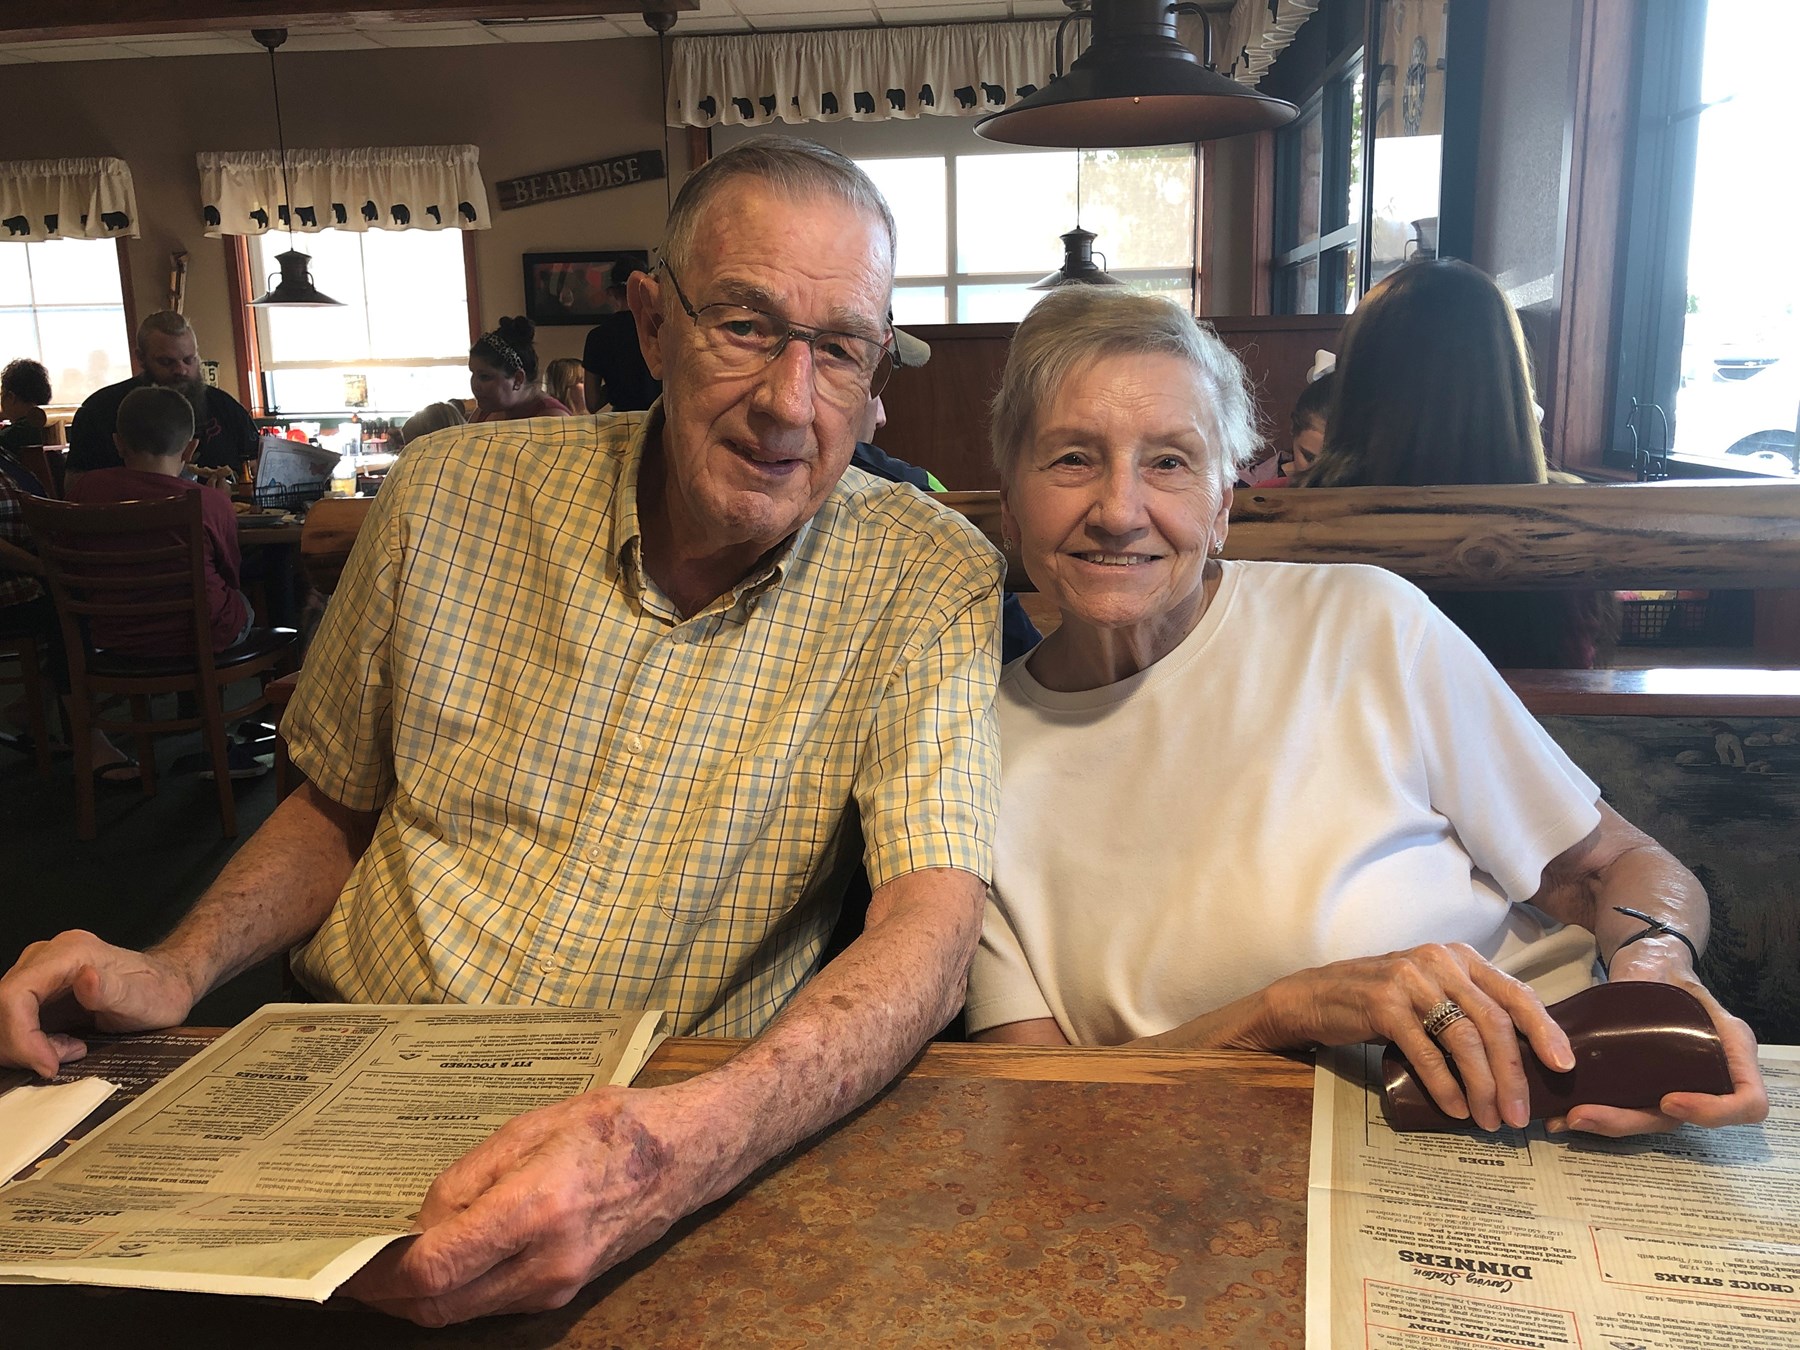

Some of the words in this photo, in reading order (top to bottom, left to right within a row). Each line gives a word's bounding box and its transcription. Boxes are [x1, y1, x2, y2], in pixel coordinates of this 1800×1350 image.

[513, 157, 642, 204] BEARADISE
[235, 1072, 310, 1081] BEVERAGES
[1458, 1157, 1505, 1166] SIDES
[1366, 1209, 1402, 1218] cornbread
[1441, 1224, 1476, 1232] described.
[1472, 1220, 1492, 1228] salad
[1374, 1230, 1398, 1238] enjoy
[1387, 1228, 1414, 1236] meant
[1454, 1230, 1475, 1238] after
[1488, 1228, 1512, 1236] platter
[1477, 1233, 1501, 1241] Daily
[1533, 1233, 1554, 1241] Enjoy
[1492, 1246, 1517, 1254] when
[1508, 1242, 1548, 1252] delicious
[1550, 1246, 1572, 1254] rich,
[1464, 1250, 1522, 1260] slow-roasted
[1545, 1252, 1576, 1260] carved
[1656, 1254, 1684, 1263] Topped
[1398, 1250, 1532, 1280] DINNERS
[1722, 1262, 1748, 1270] cals.)
[1413, 1268, 1461, 1286] Station
[1654, 1273, 1723, 1286] STEAKS
[1466, 1272, 1513, 1293] Carving
[1728, 1280, 1794, 1293] CHOICE
[1431, 1300, 1450, 1308] salad
[1696, 1300, 1732, 1310] cornbread
[1422, 1306, 1446, 1314] Served
[1732, 1304, 1774, 1316] housemade
[1740, 1312, 1762, 1320] 4pm
[1764, 1314, 1796, 1324] AFTER
[1420, 1317, 1450, 1326] AFTER
[1498, 1324, 1520, 1332] prime
[1730, 1324, 1760, 1334] finished
[1538, 1335, 1569, 1344] PRIME
